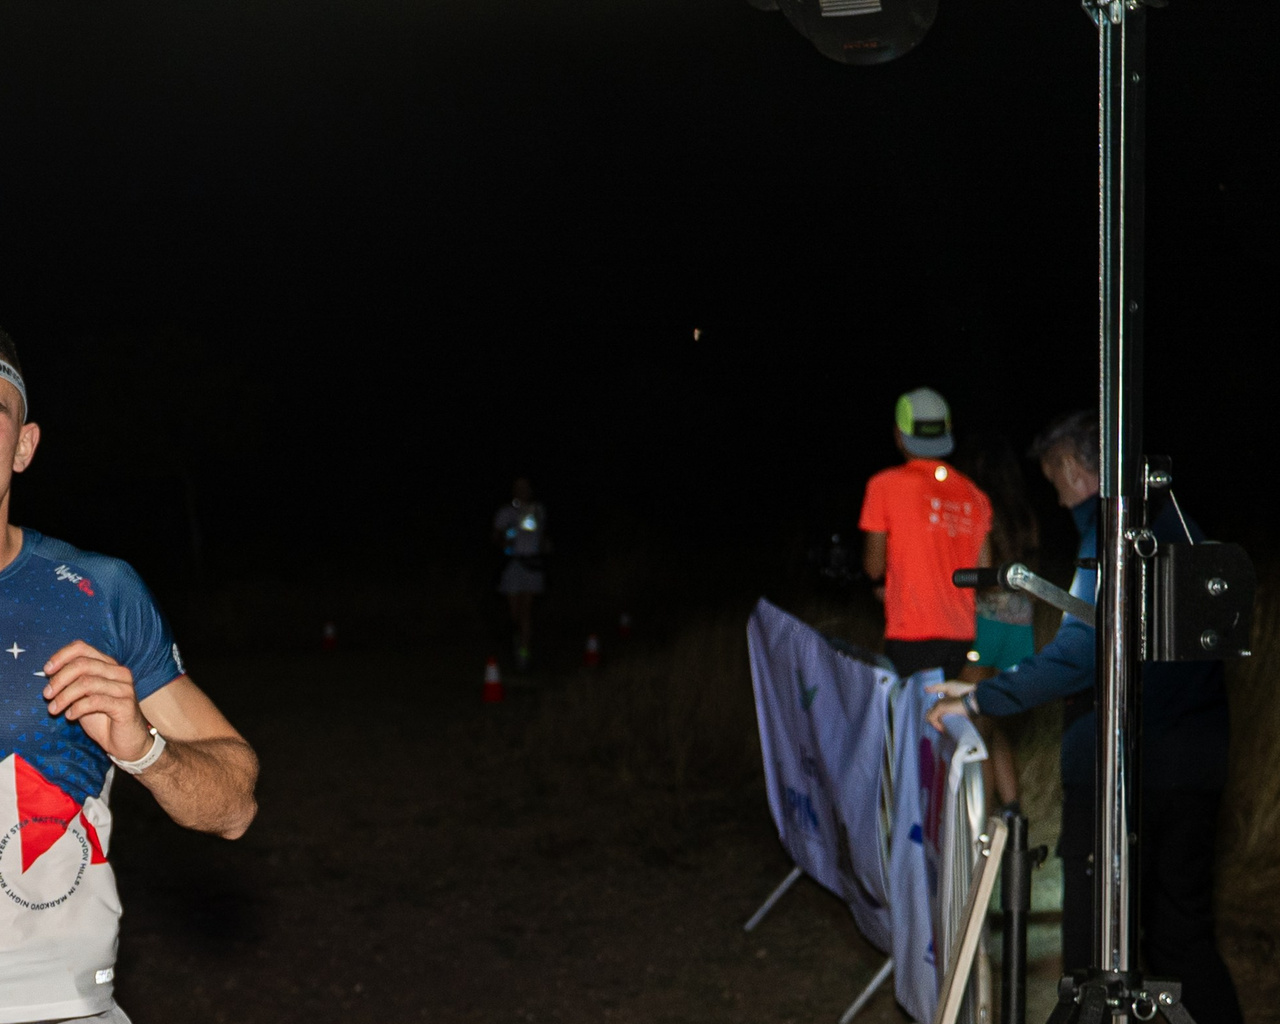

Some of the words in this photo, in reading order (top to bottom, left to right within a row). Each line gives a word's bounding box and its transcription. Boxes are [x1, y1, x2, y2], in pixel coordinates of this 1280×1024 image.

[54, 564, 83, 584] Night
[72, 828, 89, 861] PLOVDIV
[74, 863, 86, 886] HILLS
[5, 889, 30, 908] NIGHT
[67, 886, 76, 896] IN
[30, 894, 68, 910] MARKOVO
